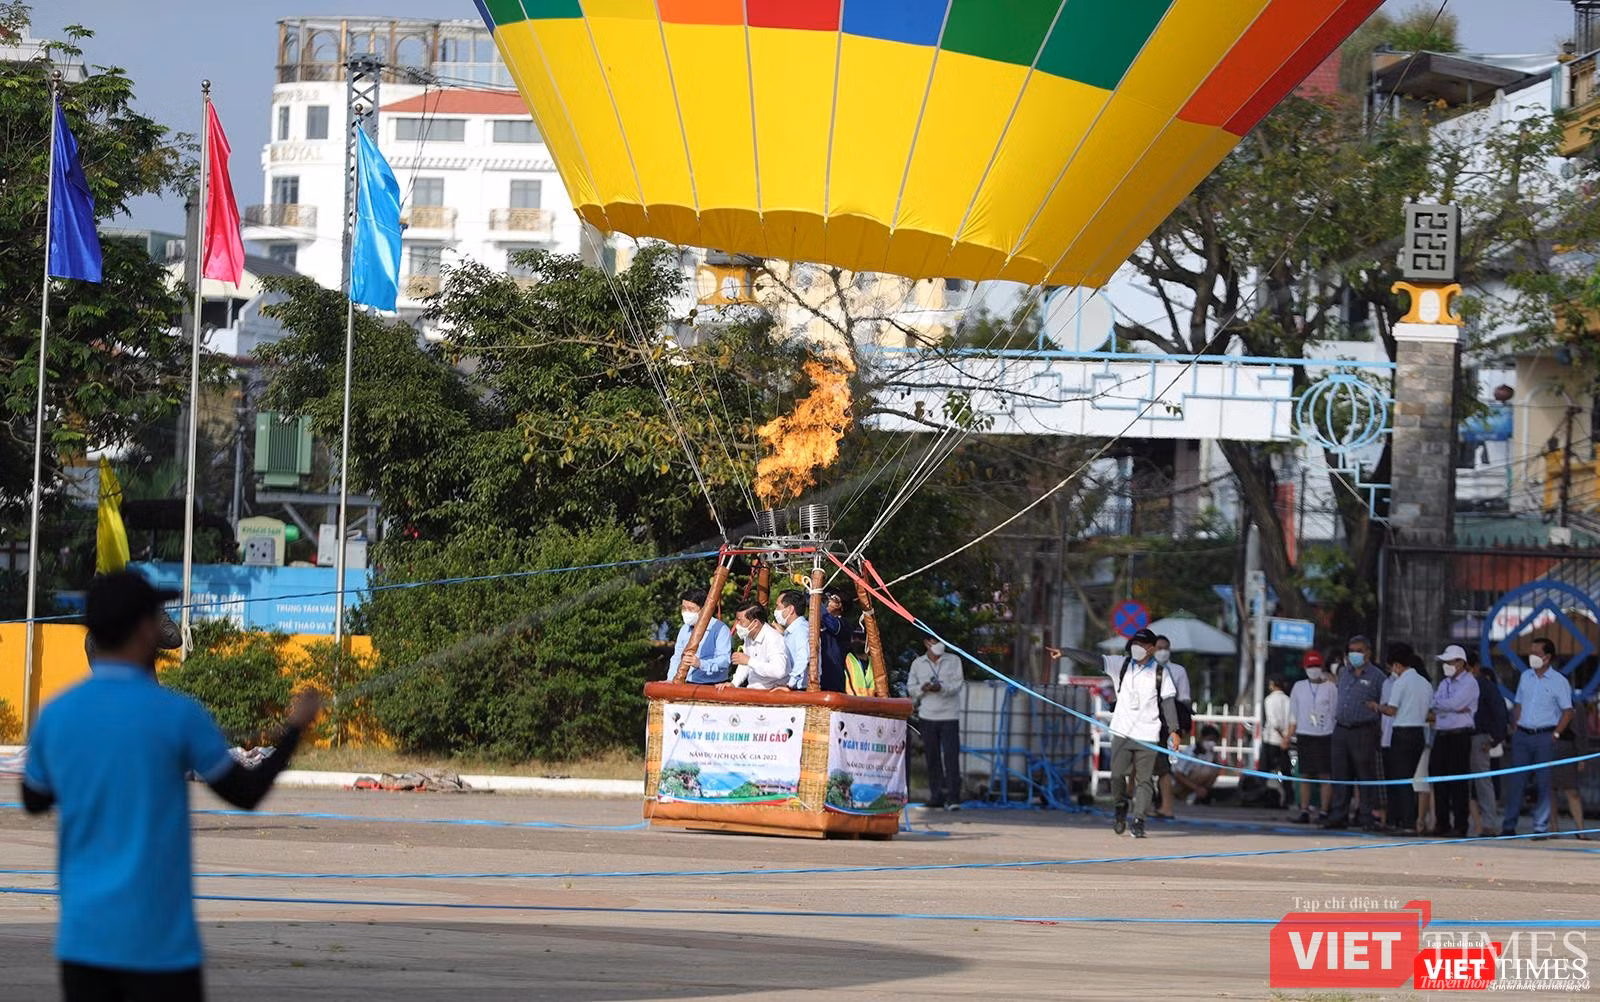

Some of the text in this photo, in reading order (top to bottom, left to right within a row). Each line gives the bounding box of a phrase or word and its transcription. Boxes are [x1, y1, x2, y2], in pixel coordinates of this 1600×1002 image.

[276, 604, 301, 613] TRUNG
[294, 620, 315, 630] THAO
[681, 729, 702, 740] NGÀY
[705, 731, 719, 743] HỘI
[723, 732, 750, 742] KHINH
[752, 732, 767, 742] KHÍ
